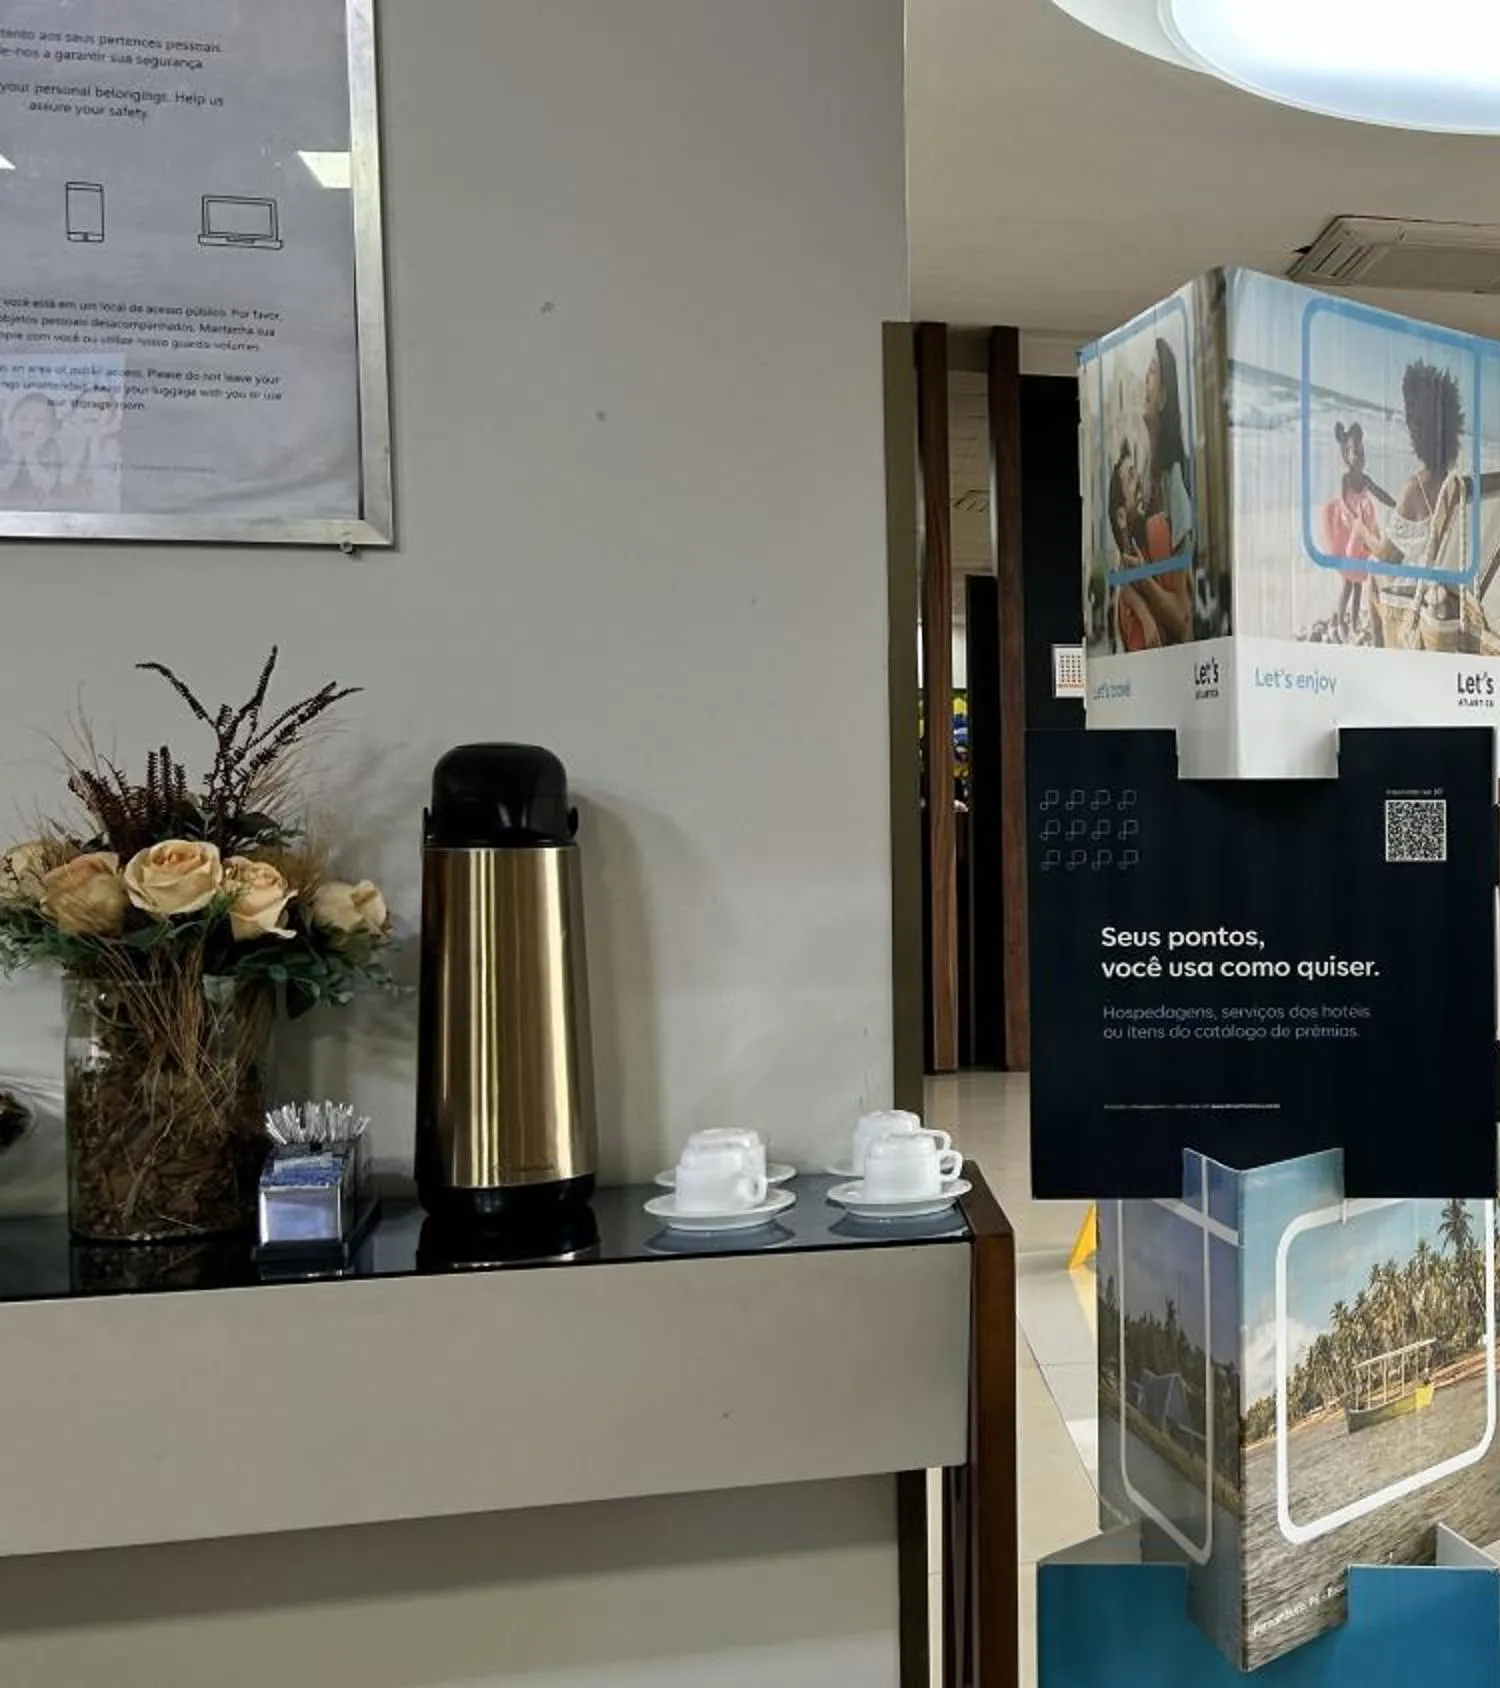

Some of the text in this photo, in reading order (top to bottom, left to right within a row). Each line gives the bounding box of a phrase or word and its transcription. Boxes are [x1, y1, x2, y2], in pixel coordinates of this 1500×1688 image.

[39, 32, 62, 41] aos
[65, 33, 95, 43] seus
[99, 35, 162, 49] pertences
[55, 51, 105, 62] garantir
[110, 56, 132, 64] sua
[35, 85, 91, 96] personal
[175, 91, 205, 106] Help
[209, 97, 224, 107] us
[29, 101, 72, 113] assure
[74, 104, 105, 117] your
[58, 301, 77, 310] em
[80, 303, 98, 311] um
[129, 304, 144, 313] de
[26, 333, 51, 342] com
[82, 335, 98, 343] ou
[199, 323, 254, 335] Mantenha
[256, 328, 276, 337] sua
[147, 367, 182, 380] Please
[184, 371, 200, 381] do
[203, 372, 222, 382] not
[224, 371, 253, 384] leave
[254, 376, 281, 387] your
[122, 386, 150, 397] your
[151, 385, 197, 400] luggage
[225, 390, 248, 402] you
[263, 391, 283, 400] use
[1194, 655, 1220, 686] Let's
[1255, 666, 1338, 696] Let's enjoy
[1456, 671, 1495, 696] Let's
[1100, 926, 1266, 951] Seus pontos,
[1100, 955, 1380, 981] você usa como quiser.
[1103, 1005, 1217, 1022] Hospedagens,
[1221, 1006, 1286, 1023] serviços
[1289, 1004, 1319, 1020] dos
[1103, 1026, 1123, 1039] ou
[1127, 1025, 1166, 1039] itens
[1169, 1024, 1192, 1039] do
[1194, 1024, 1268, 1041] catálogo
[1270, 1023, 1292, 1038] de
